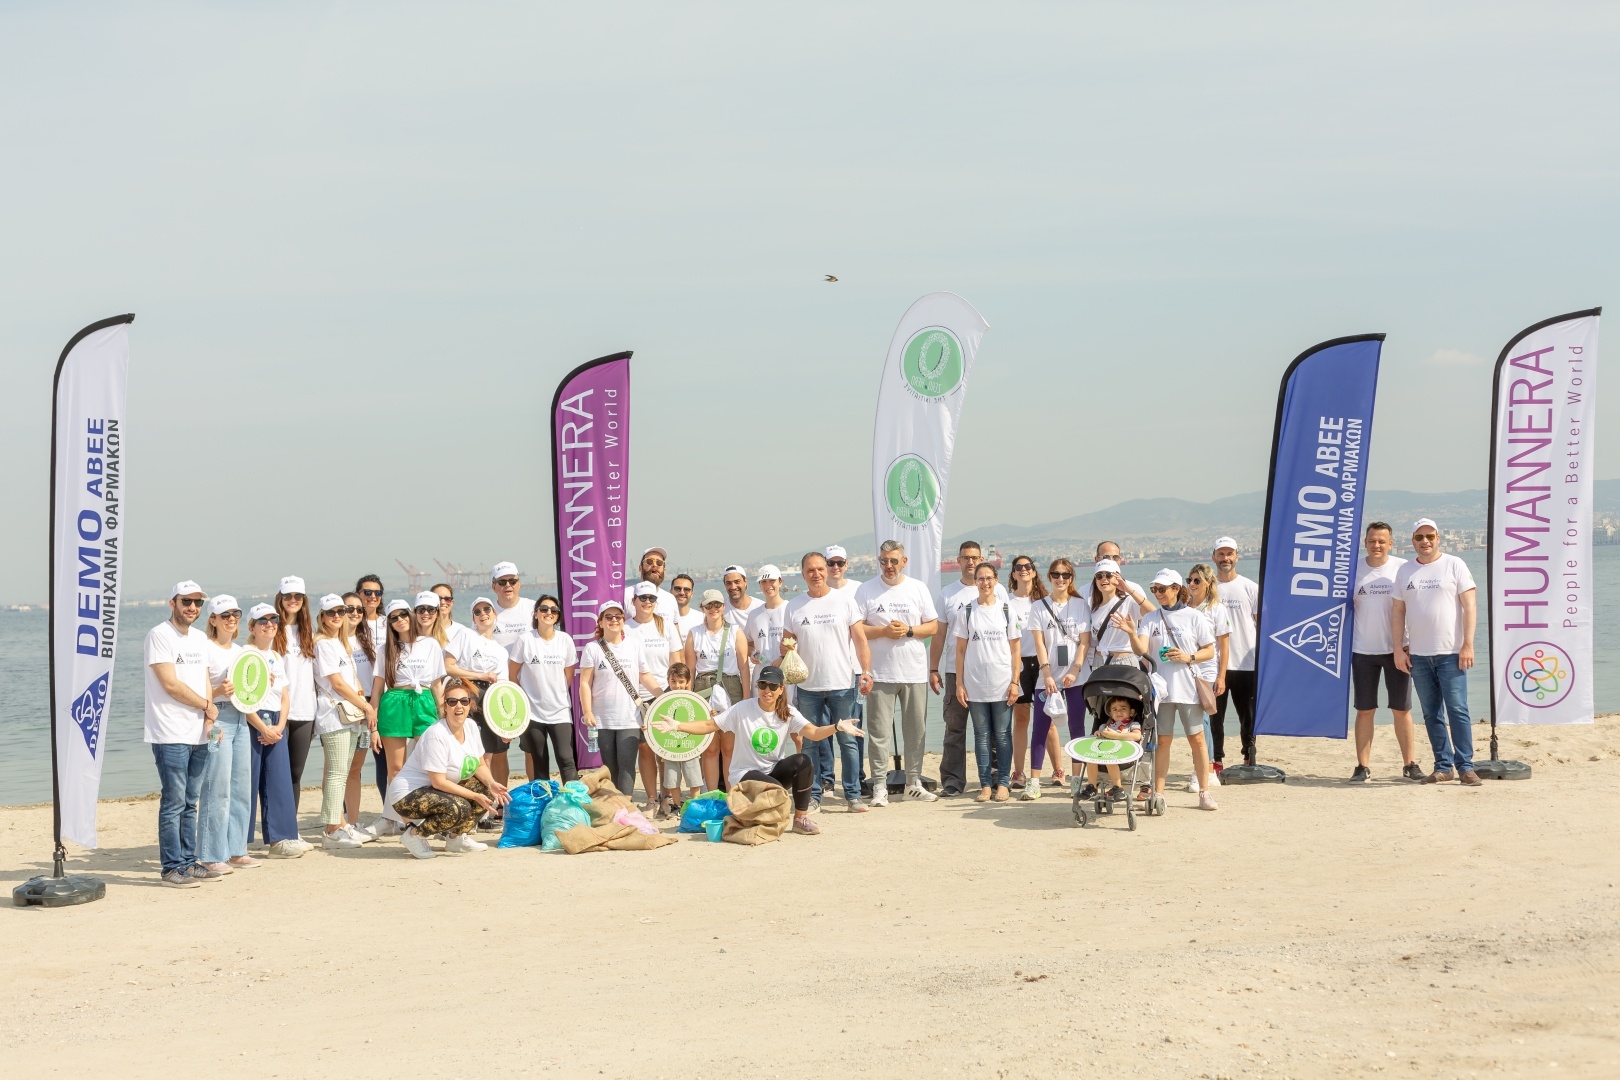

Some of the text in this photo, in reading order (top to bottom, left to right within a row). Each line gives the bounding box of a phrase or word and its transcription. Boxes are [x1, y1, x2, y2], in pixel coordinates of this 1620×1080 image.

[604, 388, 619, 449] World
[606, 461, 622, 528] Better
[1504, 345, 1555, 631] HUMANNERA
[1562, 346, 1583, 628] People for a Better World
[560, 388, 599, 676] UMANNERA
[611, 540, 622, 549] a
[1290, 485, 1337, 598] DEMO
[76, 509, 103, 657] DEMO
[609, 560, 623, 589] for
[1325, 613, 1341, 665] DEMO
[89, 679, 107, 750] DEMO
[663, 739, 678, 748] ZERO
